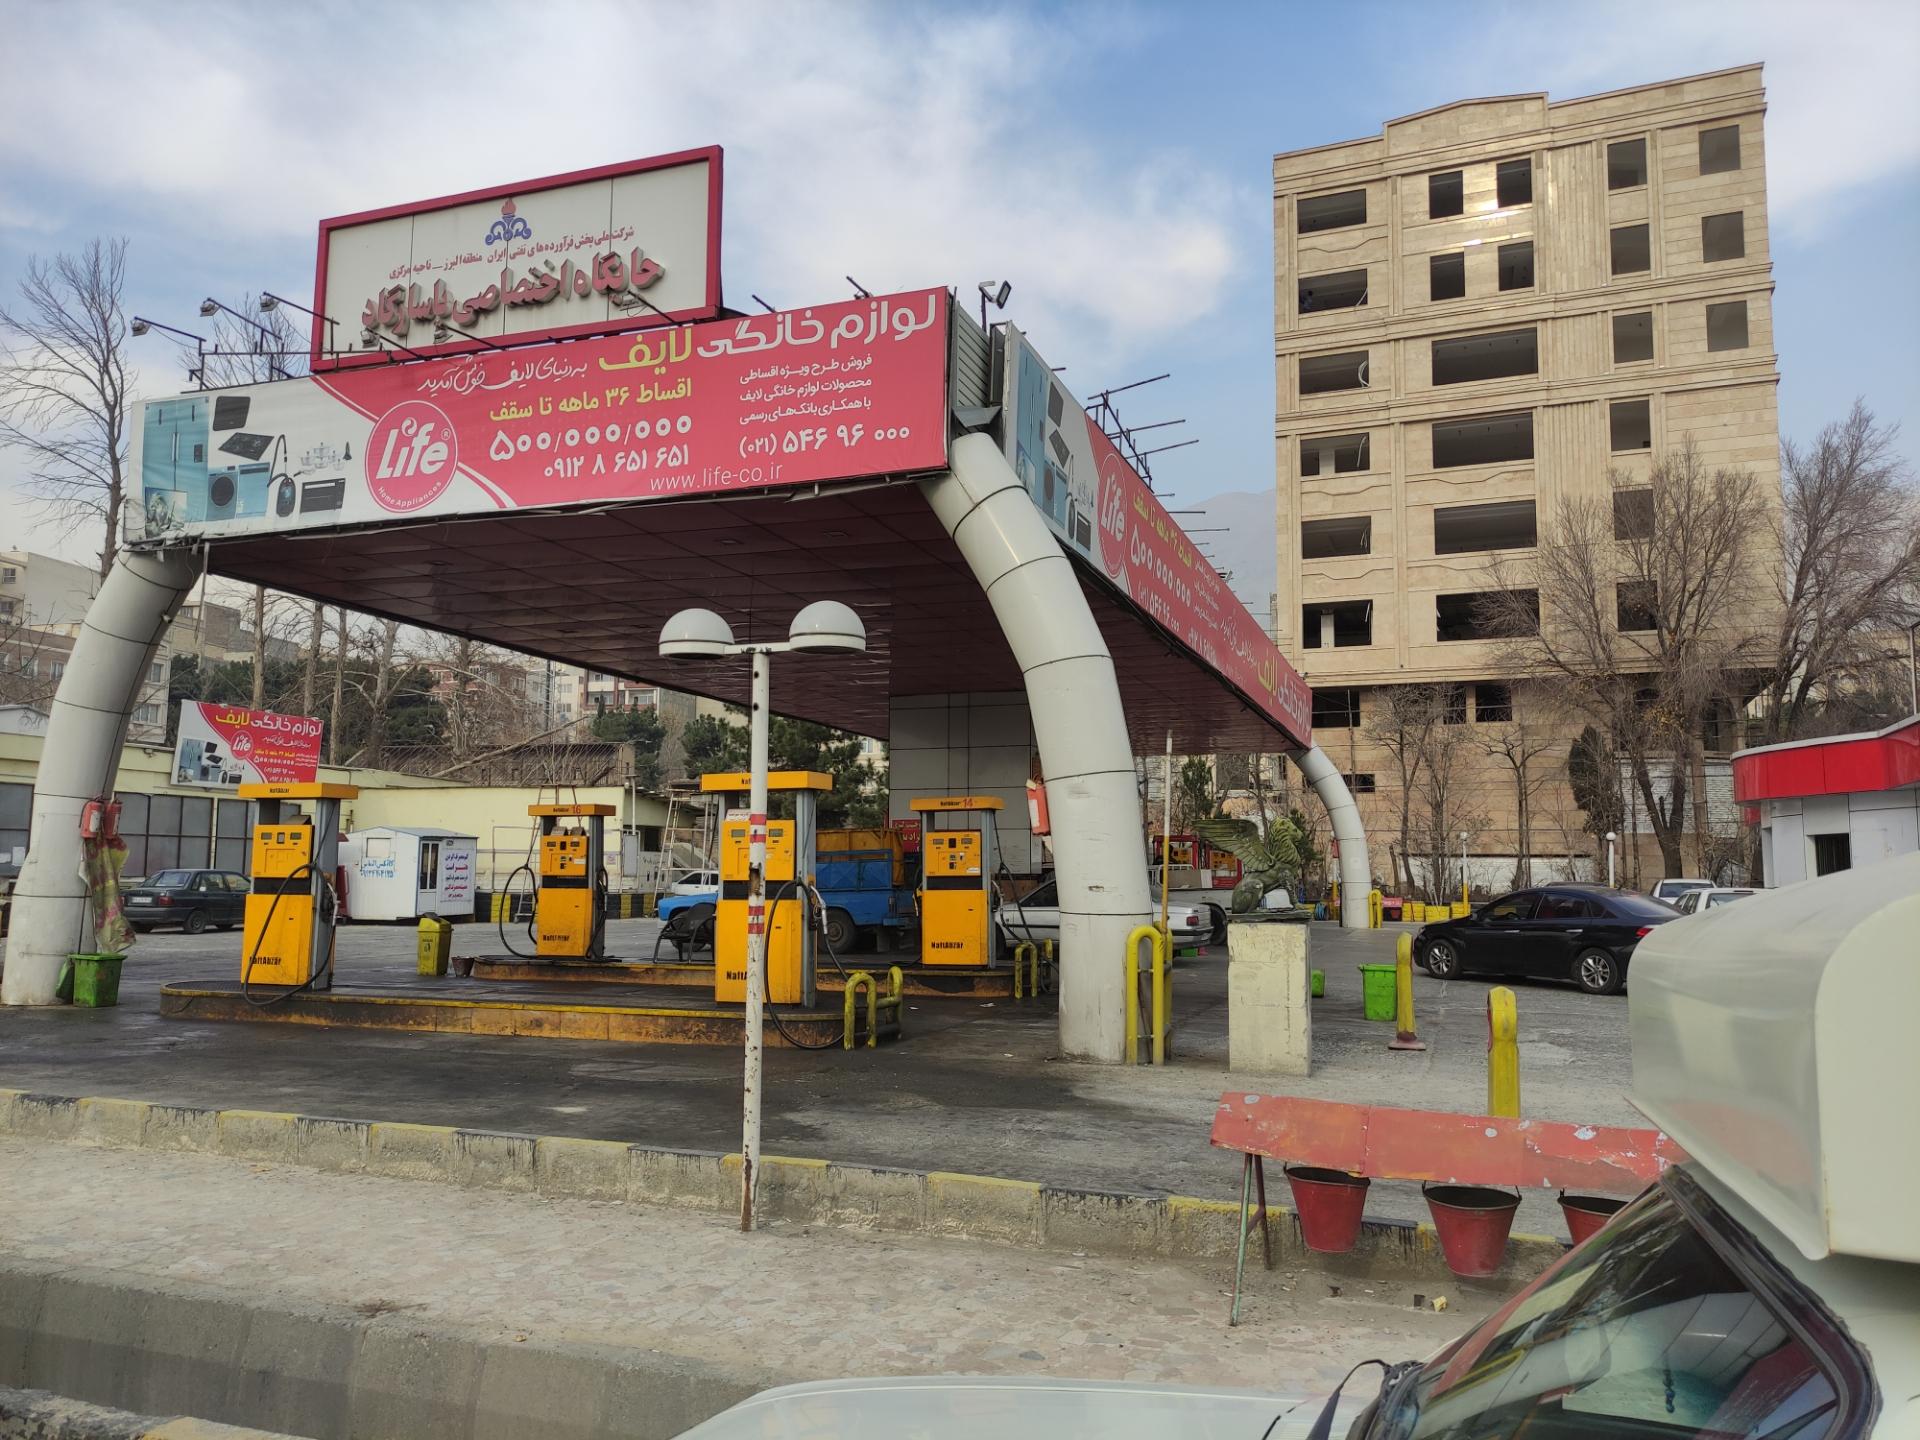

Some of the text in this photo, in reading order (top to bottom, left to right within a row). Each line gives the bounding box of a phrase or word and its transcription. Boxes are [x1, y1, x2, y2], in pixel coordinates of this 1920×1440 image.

[575, 233, 593, 249] پخش
[594, 231, 611, 246] ملی
[611, 226, 634, 241] شرکت
[463, 253, 482, 265] منطقه
[487, 248, 506, 263] ایران
[509, 244, 526, 260] نفتی
[389, 264, 410, 280] مرکزی
[413, 259, 432, 275] ناحیه
[599, 294, 936, 375] لوازم خانگی لایف
[739, 353, 873, 384] فروش طرح ویژه اقساطی
[417, 365, 459, 398] آمدید
[739, 378, 872, 403] محصولات لوازم خانگی لایف
[489, 377, 691, 422] اقساط ۳۶ ماهه تا سقف
[817, 397, 862, 416] همکاری
[863, 396, 872, 410] با
[739, 409, 768, 425] رسمی
[489, 415, 692, 461] ۵۰۰/۰۰۰/۰۰۰
[739, 423, 910, 459] (۰۲۱) ۵۴۶ ۹۶ ۰۰۰
[376, 416, 448, 480] Life
[544, 444, 689, 478] ۰۹۱۲ ۸ ۶۵۱ ۶۵۱
[650, 461, 783, 491] www.life-co.ir
[1101, 472, 1126, 542] Life
[215, 710, 322, 737] لوازم خانگی لایف
[232, 734, 251, 751] Life
[571, 804, 581, 814] 16
